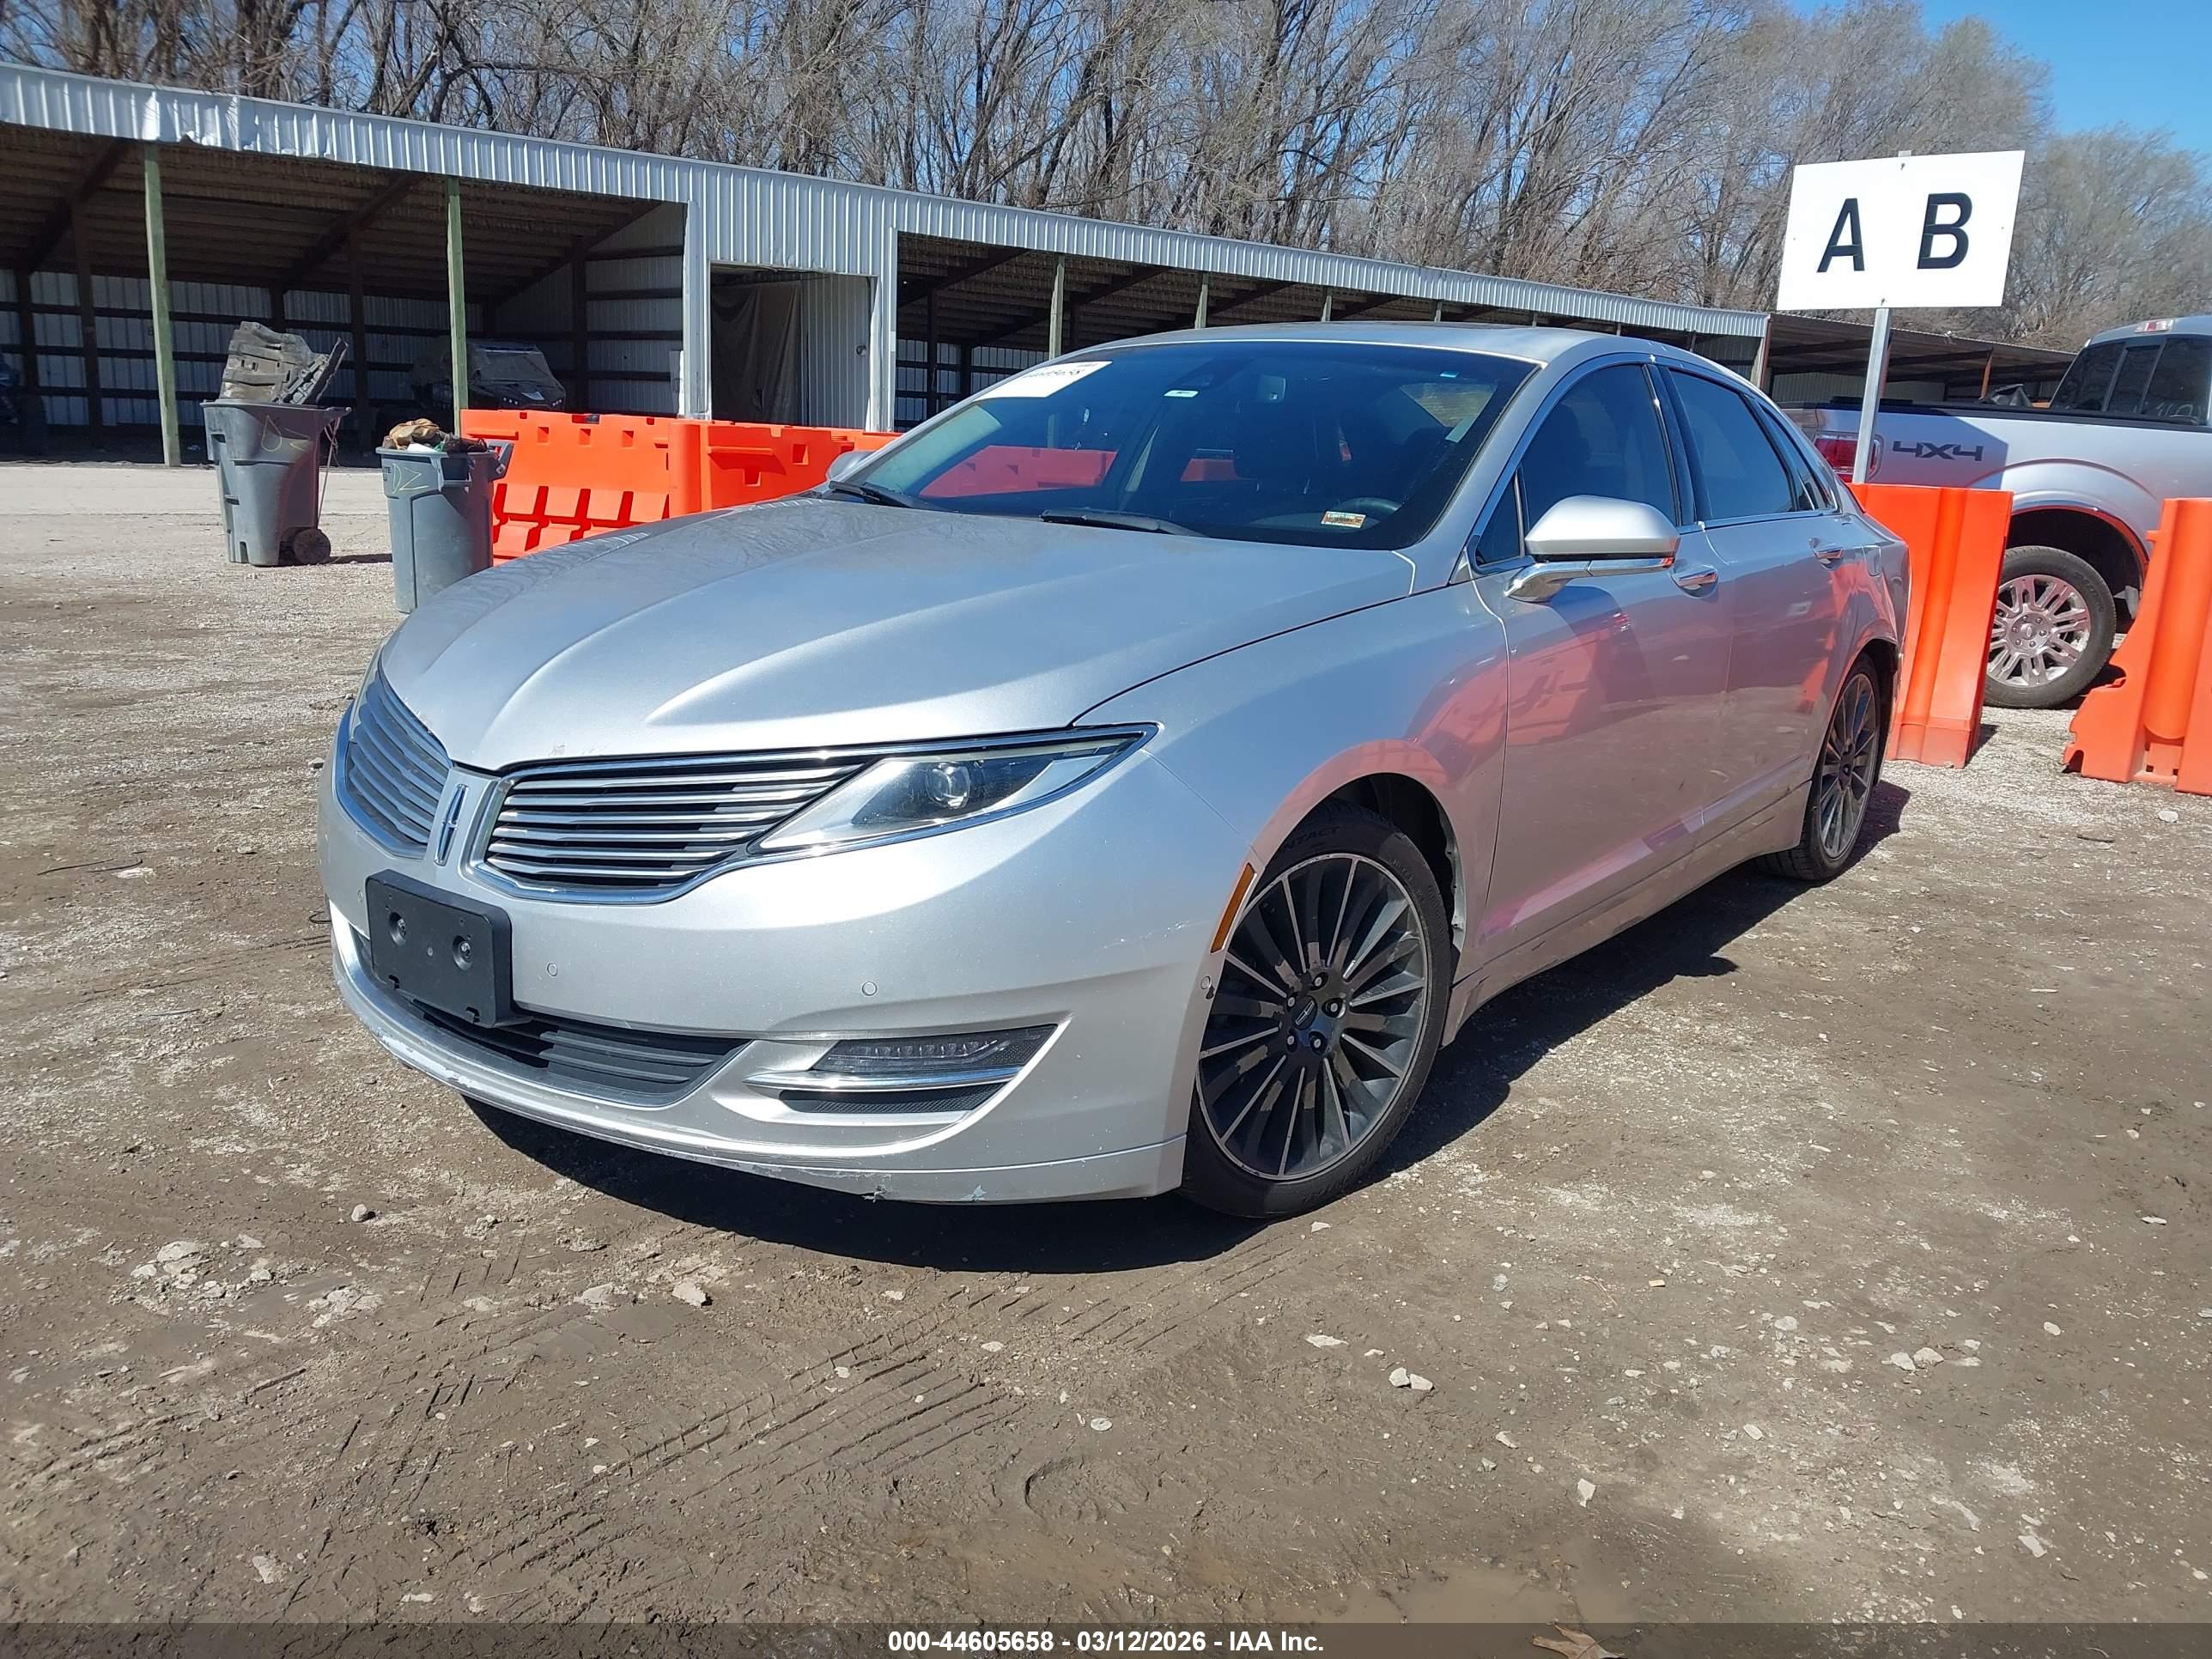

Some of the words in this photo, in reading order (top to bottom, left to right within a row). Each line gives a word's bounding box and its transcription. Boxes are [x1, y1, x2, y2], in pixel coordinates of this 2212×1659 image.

[1816, 198, 1865, 273] A
[1916, 192, 1973, 270] B
[1892, 440, 1985, 462] 4X4
